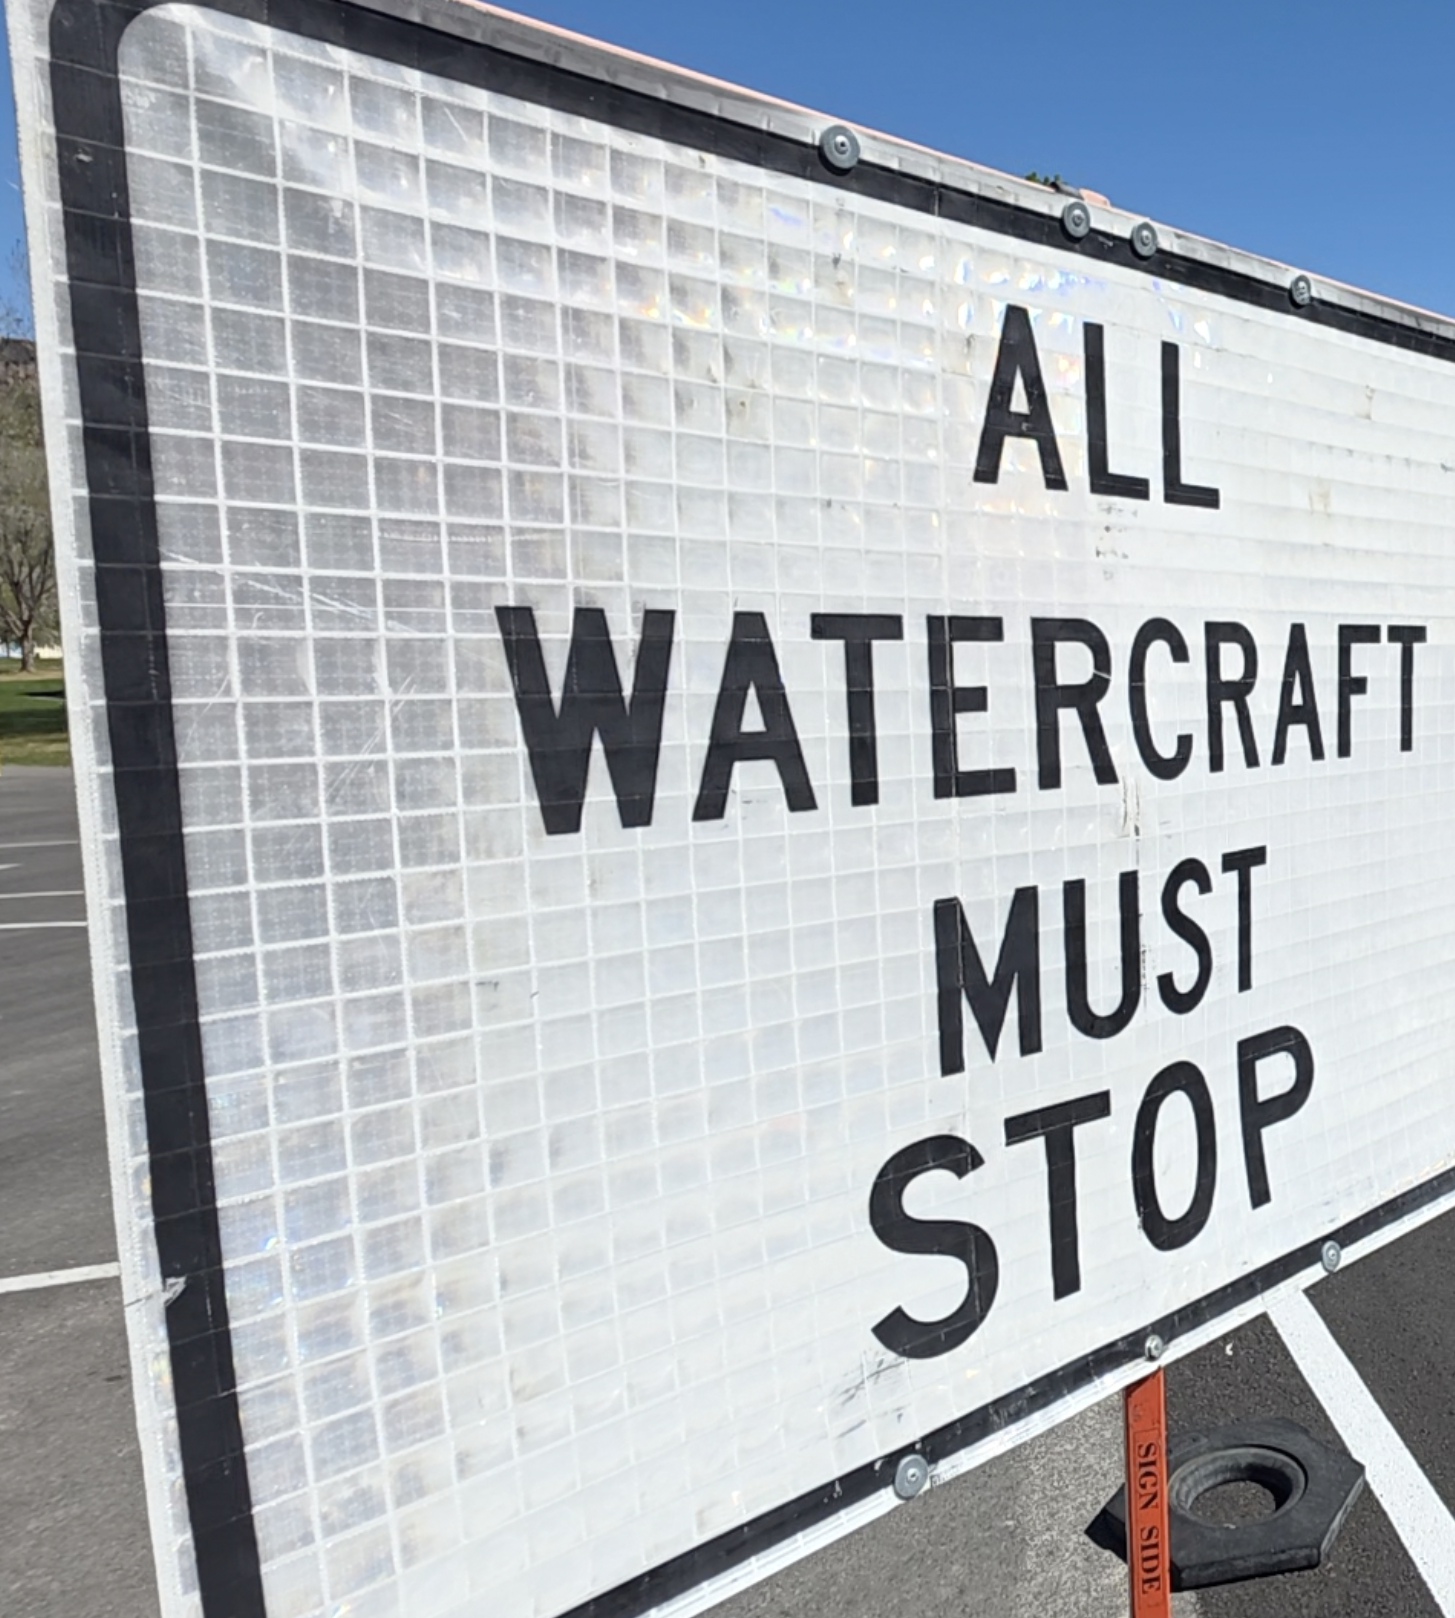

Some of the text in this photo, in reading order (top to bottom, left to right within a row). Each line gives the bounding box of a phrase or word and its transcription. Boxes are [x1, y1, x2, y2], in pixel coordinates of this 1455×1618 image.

[974, 305, 1219, 508] ALL
[495, 606, 1425, 834] WATERCRAFT
[934, 846, 1266, 1076] MUST
[870, 1026, 1313, 1358] STOP
[1138, 1442, 1161, 1595] SIGN SIDE
